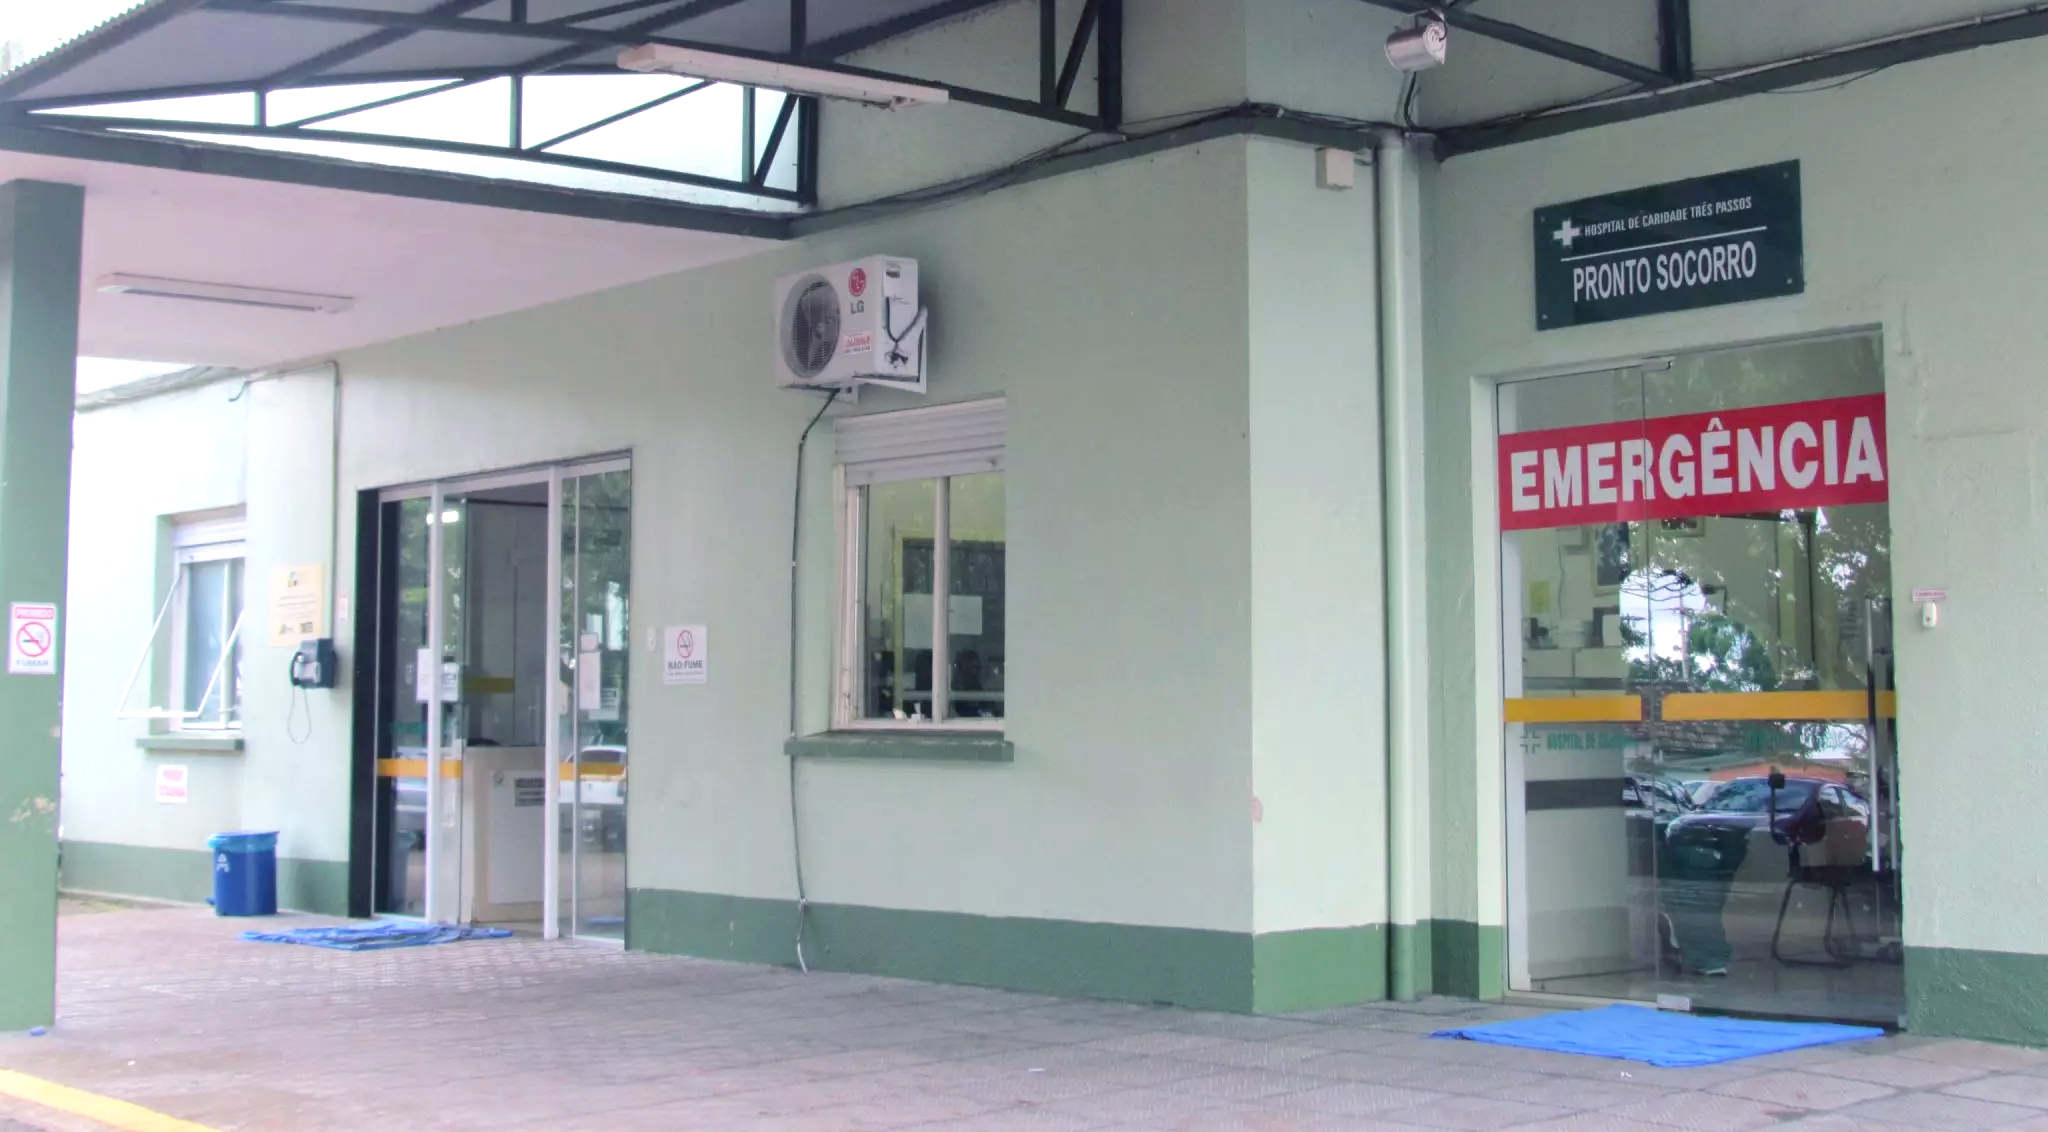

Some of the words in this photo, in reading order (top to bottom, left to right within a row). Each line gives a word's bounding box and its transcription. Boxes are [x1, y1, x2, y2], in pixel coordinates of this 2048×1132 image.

[1585, 219, 1626, 237] HOSPITAL
[1628, 216, 1640, 230] DE
[1642, 208, 1688, 228] CARIDADE
[1715, 196, 1752, 215] PASSOS
[1573, 257, 1651, 302] PRONTO
[1656, 241, 1757, 291] SOCORRO
[850, 300, 865, 314] LG
[1510, 416, 1885, 513] EMERGÊNCIA
